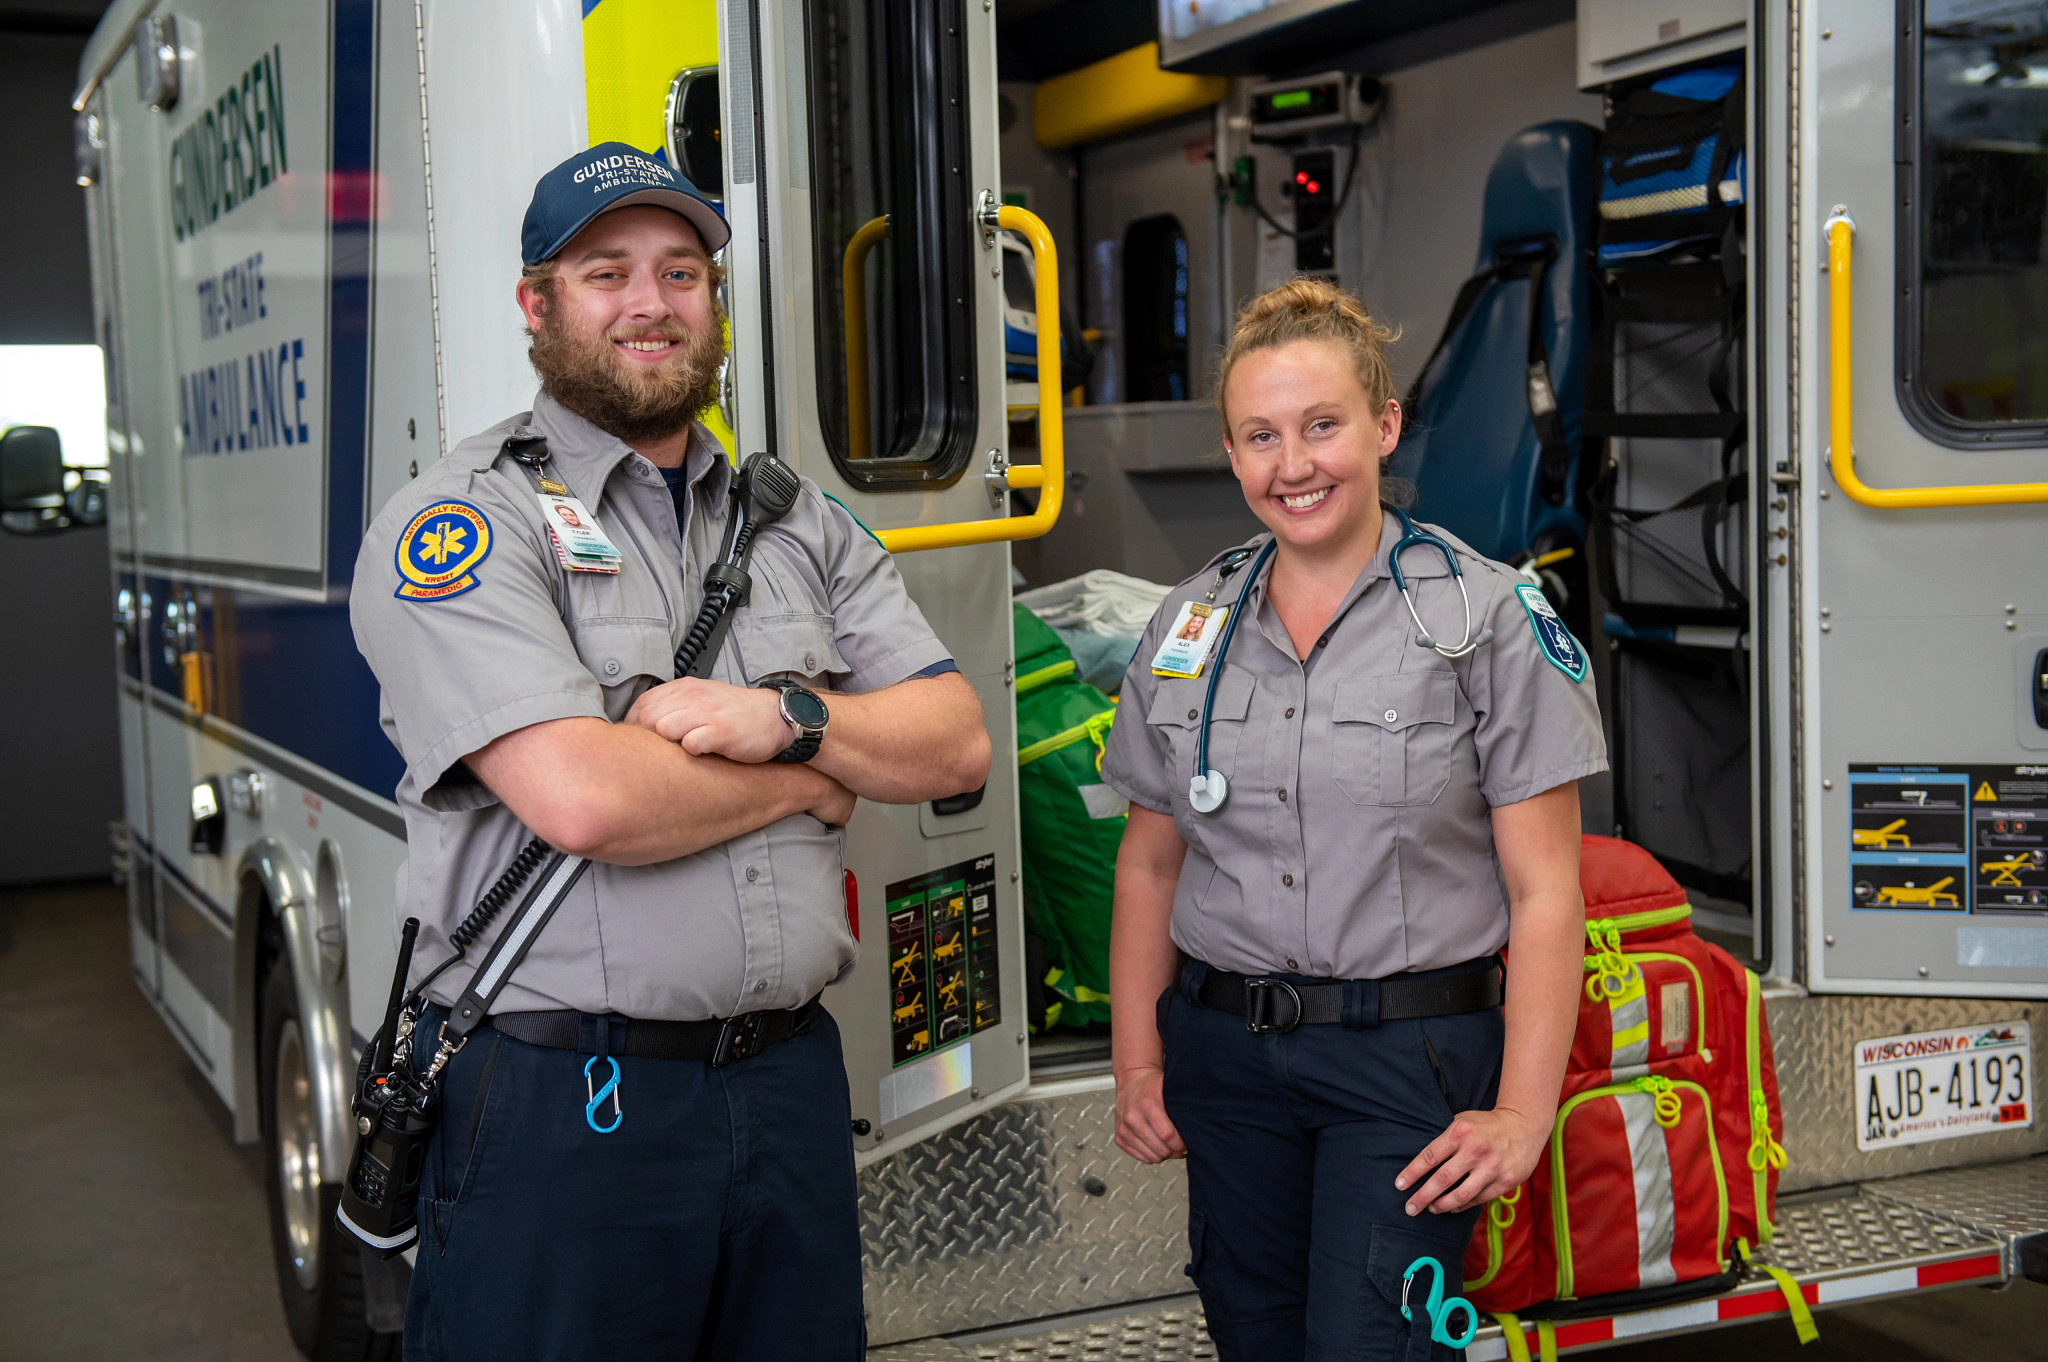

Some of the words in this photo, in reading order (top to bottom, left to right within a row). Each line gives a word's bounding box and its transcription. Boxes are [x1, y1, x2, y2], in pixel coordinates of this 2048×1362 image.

[169, 43, 287, 242] GUNDERSEN
[573, 155, 675, 183] GUNDERSEN
[597, 168, 660, 181] TRI-STATE
[593, 176, 667, 194] AMBULANC
[197, 252, 267, 340] TRI-STATE
[181, 338, 309, 458] AMBULANCE
[404, 505, 448, 541] NATIONALLY
[450, 505, 485, 531] CERTIFIED
[411, 582, 463, 597] PARAMEDIC
[424, 572, 454, 583] NREMT
[2014, 765, 2048, 776] stryke
[1862, 1036, 1954, 1064] WISCONSIN
[1867, 1054, 2025, 1126] AJB-4193
[1865, 1124, 1887, 1142] JAN
[1899, 1118, 1945, 1133] America's
[1947, 1111, 1992, 1126] Dairyland
